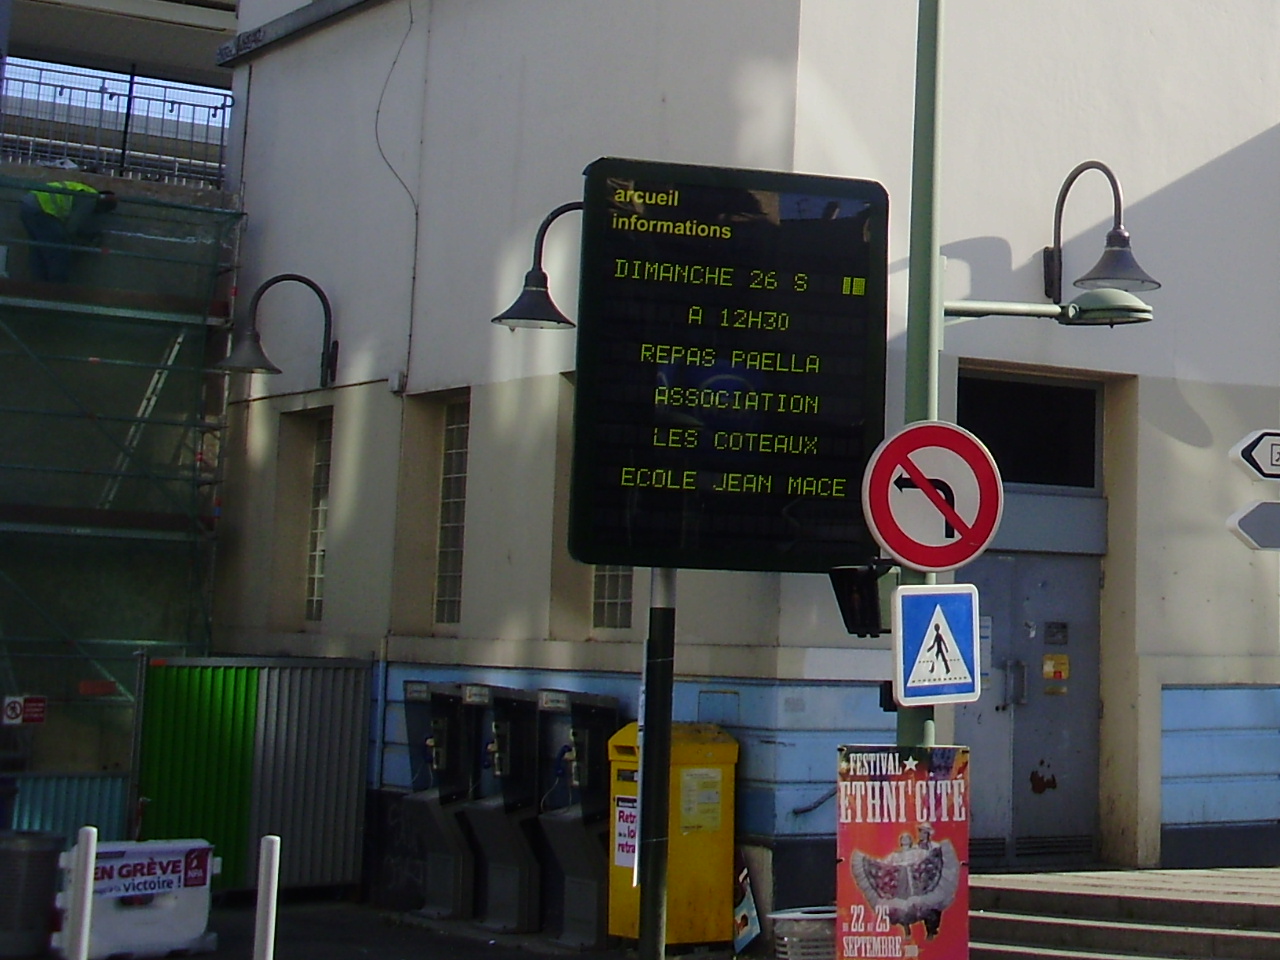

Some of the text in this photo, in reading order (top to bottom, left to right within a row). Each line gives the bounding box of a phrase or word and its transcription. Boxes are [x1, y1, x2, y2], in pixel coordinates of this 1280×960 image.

[615, 187, 679, 207] arcueil
[612, 214, 732, 239] informations
[615, 259, 733, 287] DIMANCHE
[750, 270, 778, 291] 26
[688, 306, 790, 331] A 12H30
[641, 344, 820, 373] REPAS PAELLA
[654, 386, 819, 414] ASSOCIATION
[654, 427, 818, 455] LES COTEAUX
[621, 467, 847, 498] ECOLE JEAN MACE
[850, 753, 902, 776] FESTIVAL
[618, 810, 637, 824] Retr
[618, 841, 635, 854] retra
[118, 856, 182, 878] GRÈVE
[123, 875, 173, 892] victoire
[850, 905, 890, 932] 22 25
[843, 936, 902, 958] SEPTEMBRE
